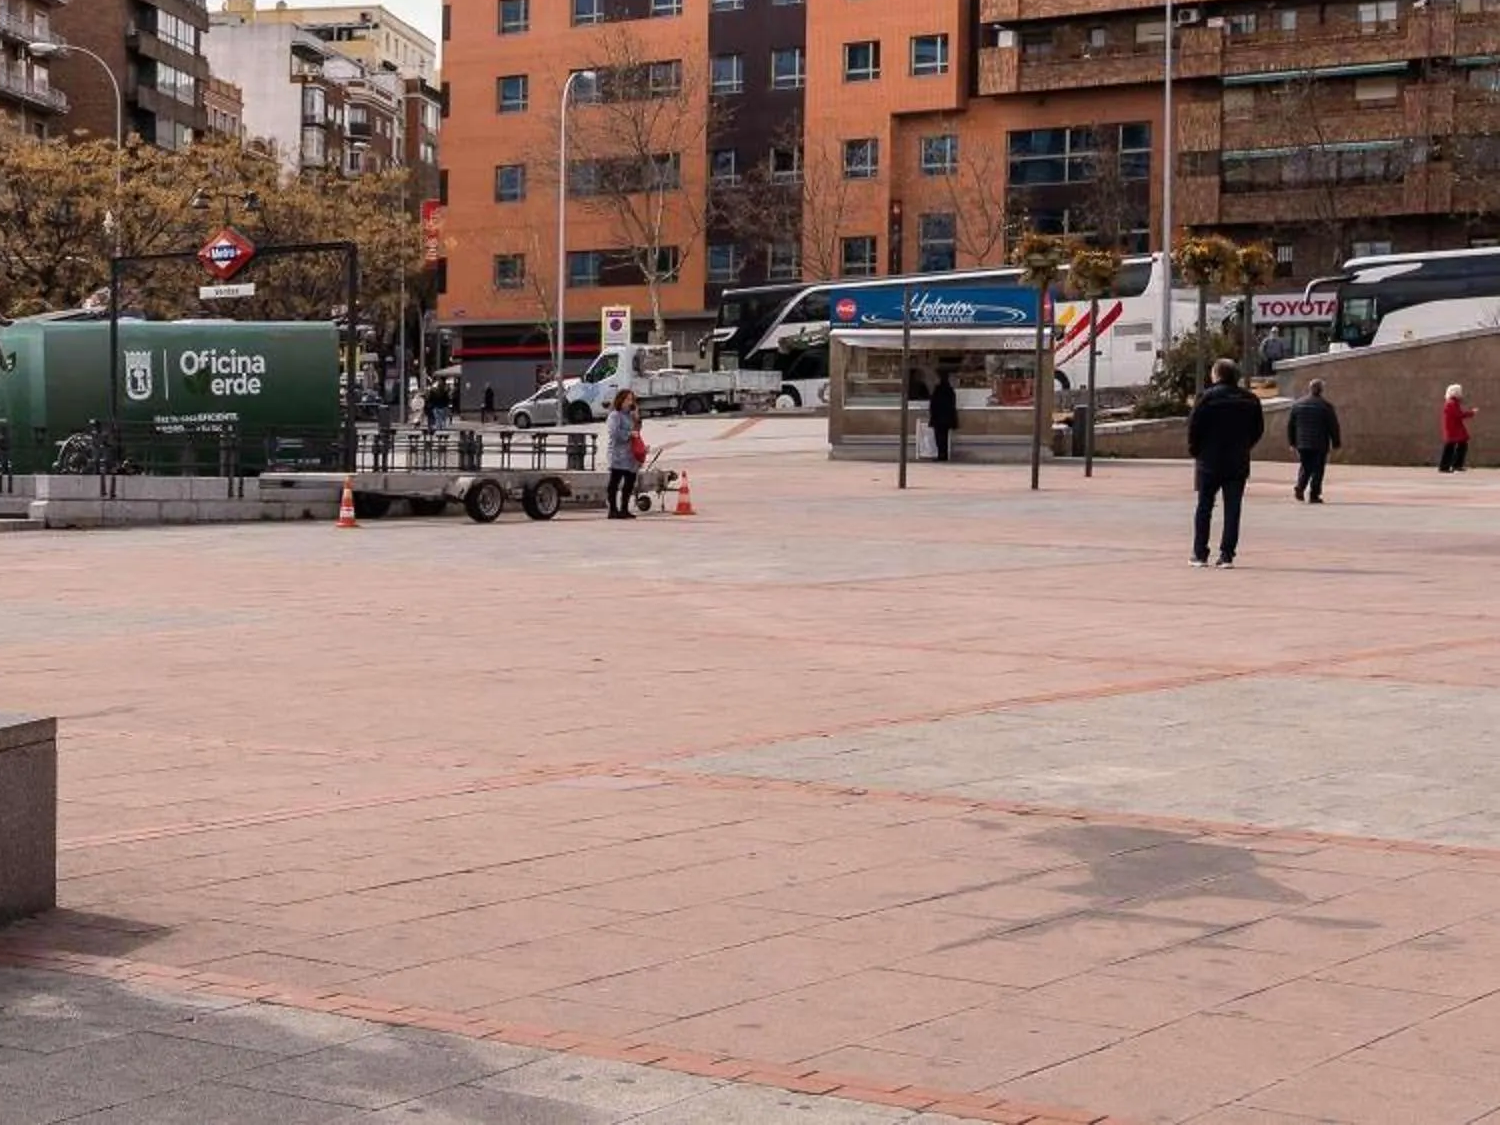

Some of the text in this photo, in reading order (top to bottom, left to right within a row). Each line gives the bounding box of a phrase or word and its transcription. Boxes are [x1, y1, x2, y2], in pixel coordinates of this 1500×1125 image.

[211, 247, 236, 260] Metro
[1258, 299, 1336, 316] TOYOTA
[180, 348, 266, 376] Oficina
